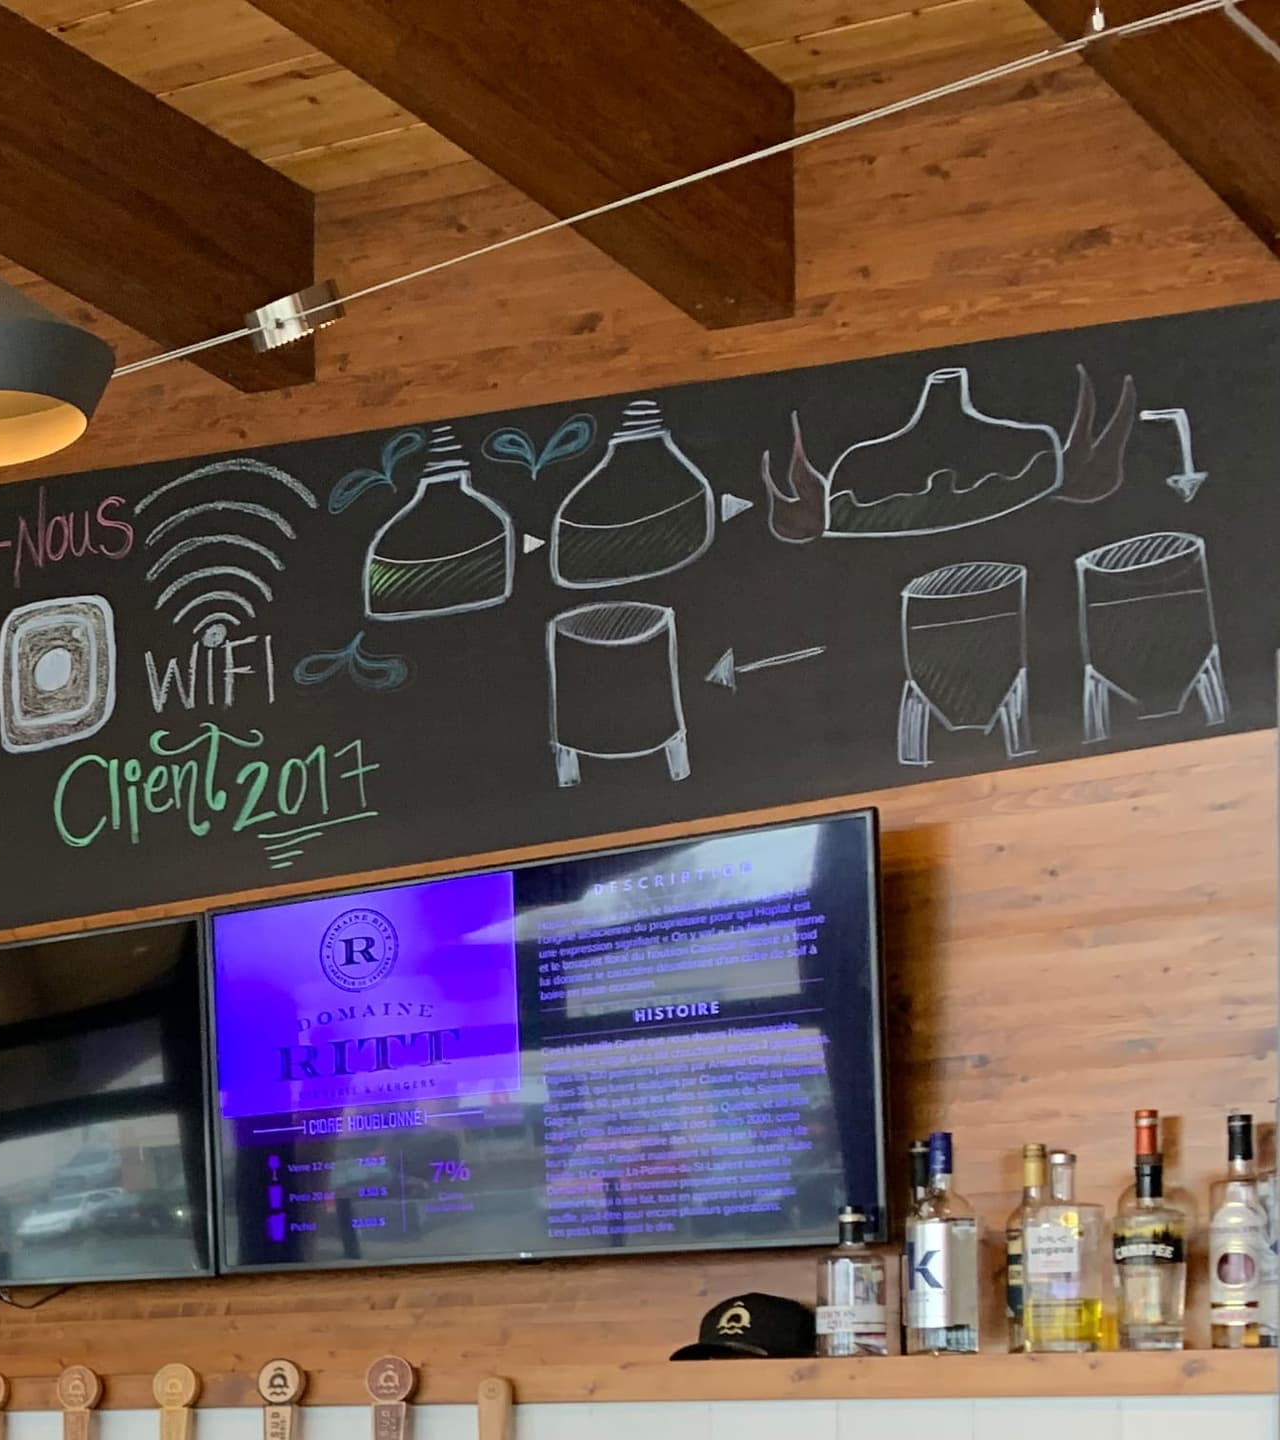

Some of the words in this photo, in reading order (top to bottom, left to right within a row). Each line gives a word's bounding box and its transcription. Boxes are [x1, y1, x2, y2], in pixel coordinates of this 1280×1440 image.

[53, 722, 264, 847] Client
[233, 739, 380, 832] 2017
[338, 936, 380, 967] R
[296, 1001, 435, 1033] DOMAINE
[634, 1001, 721, 1023] HISTOIRE
[275, 1027, 462, 1083] RITT
